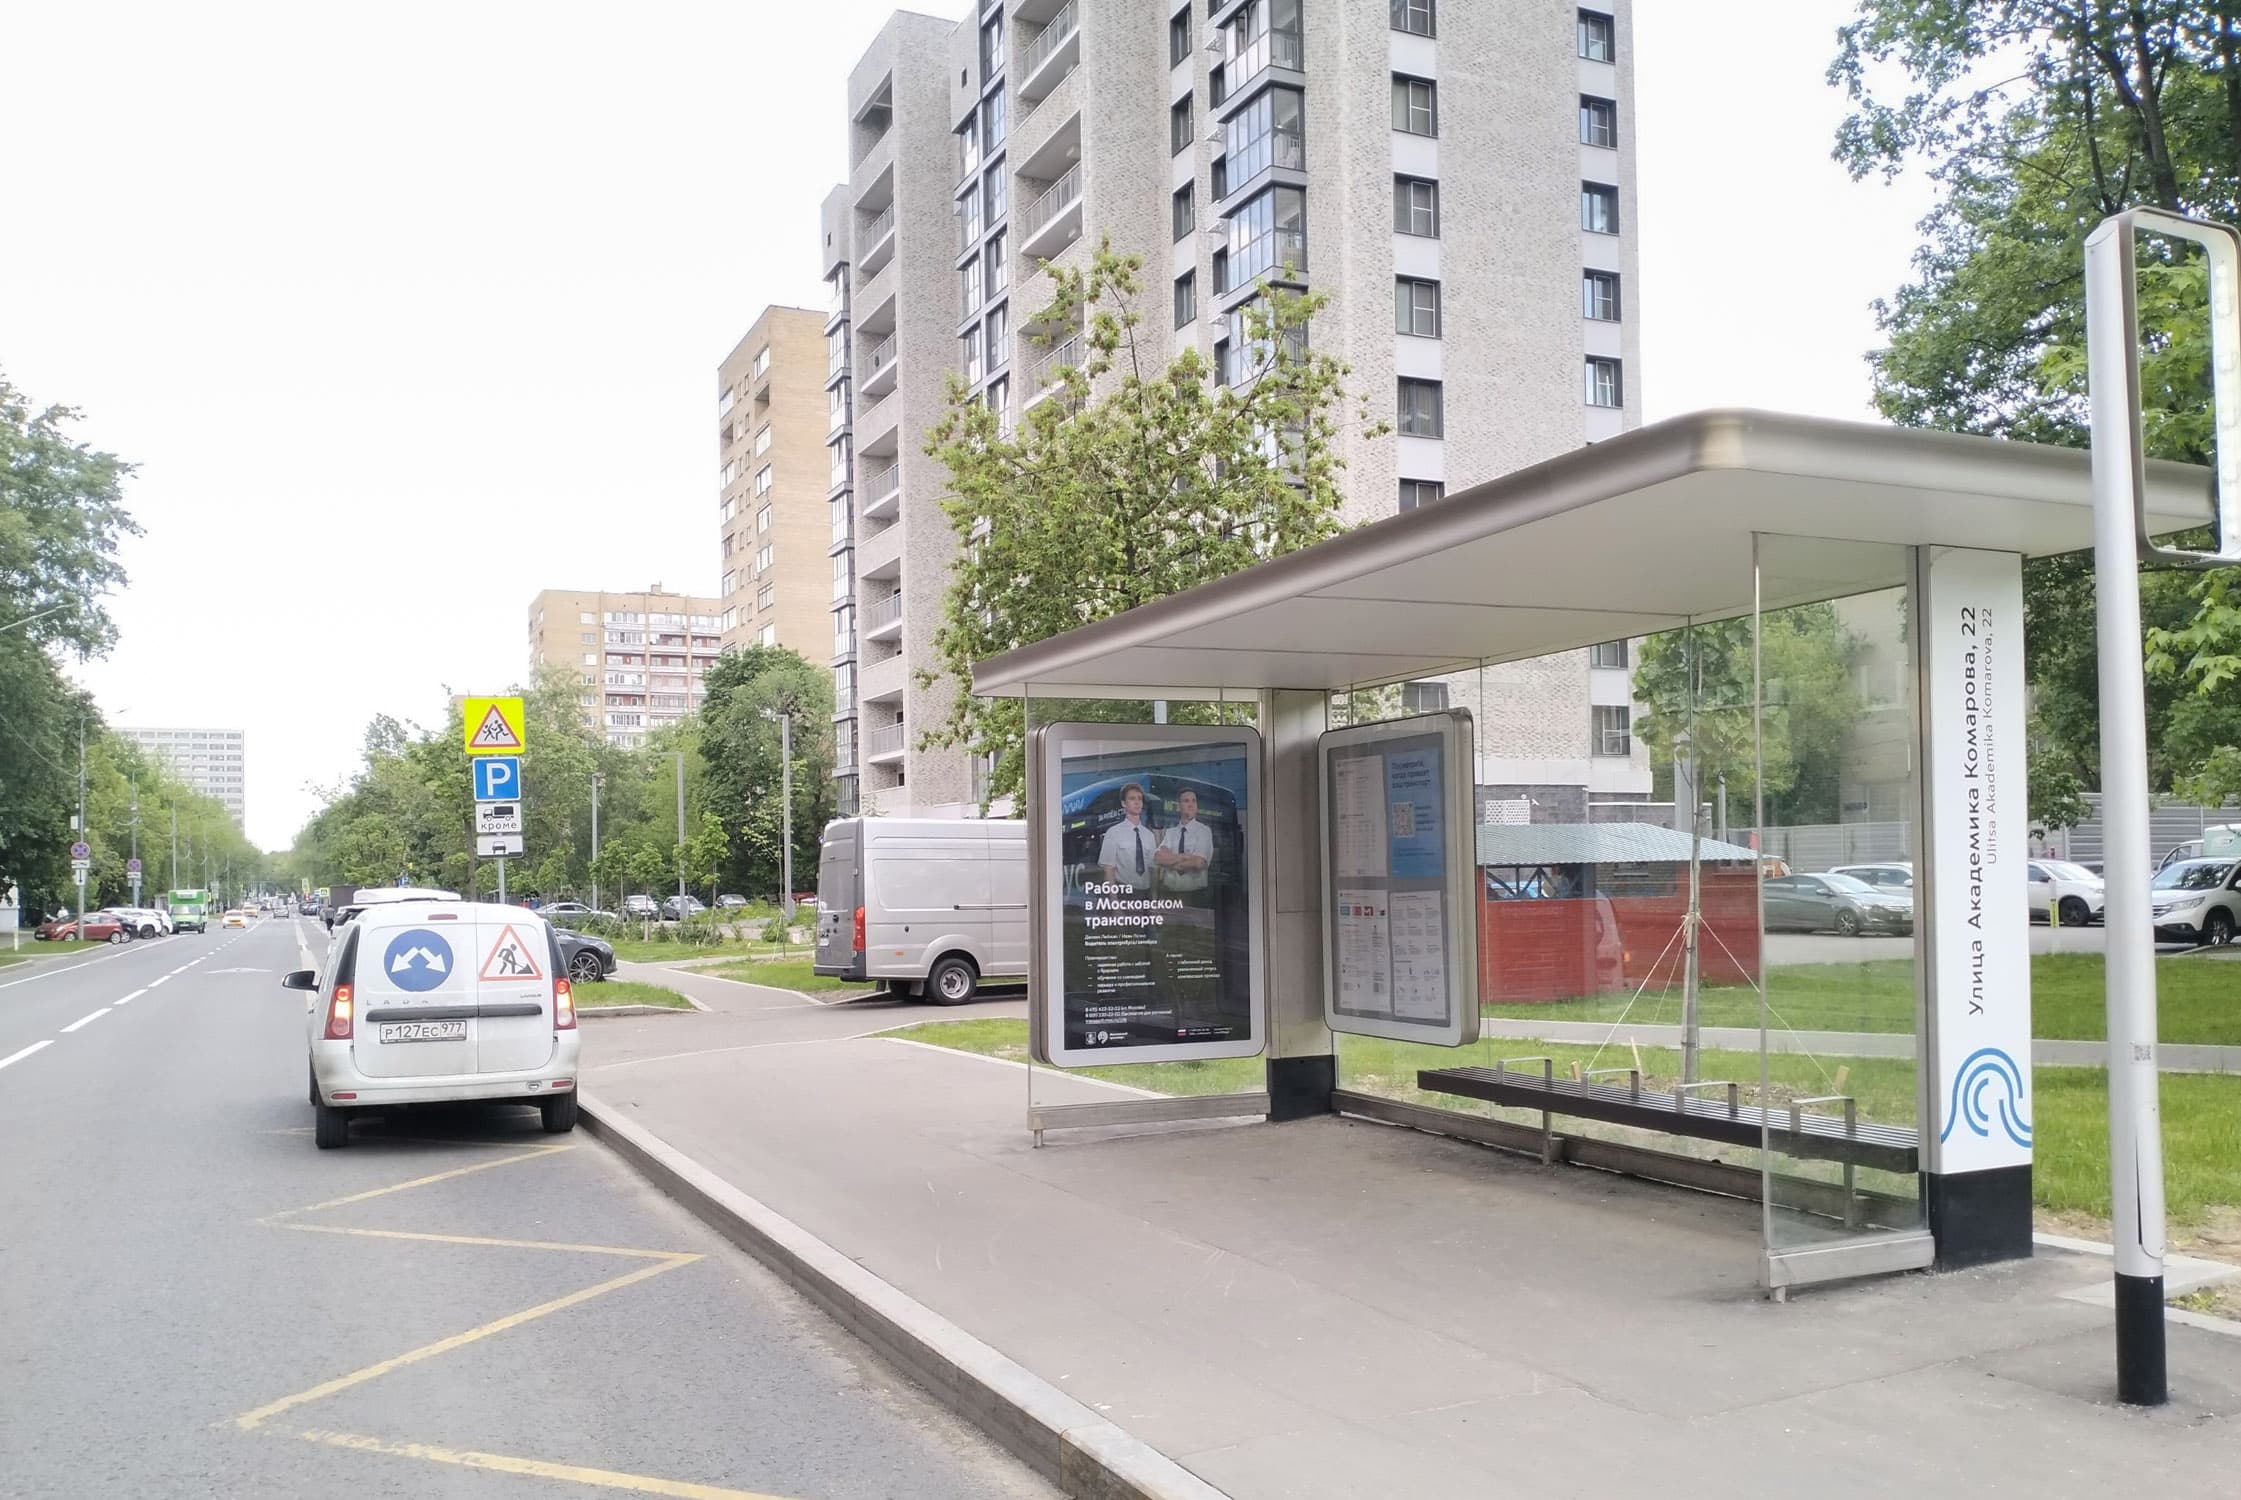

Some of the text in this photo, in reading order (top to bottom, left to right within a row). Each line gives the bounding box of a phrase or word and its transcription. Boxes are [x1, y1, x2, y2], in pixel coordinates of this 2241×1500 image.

[1982, 608, 1997, 864] Ulitsa Akademika Komarova, 22
[486, 763, 511, 796] P
[1961, 607, 1984, 1015] Улица Академика Комарова, 22
[481, 822, 517, 831] кроме
[1084, 881, 1133, 895] Работа
[1084, 898, 1183, 911] в Московском
[1084, 915, 1164, 930] транспорте
